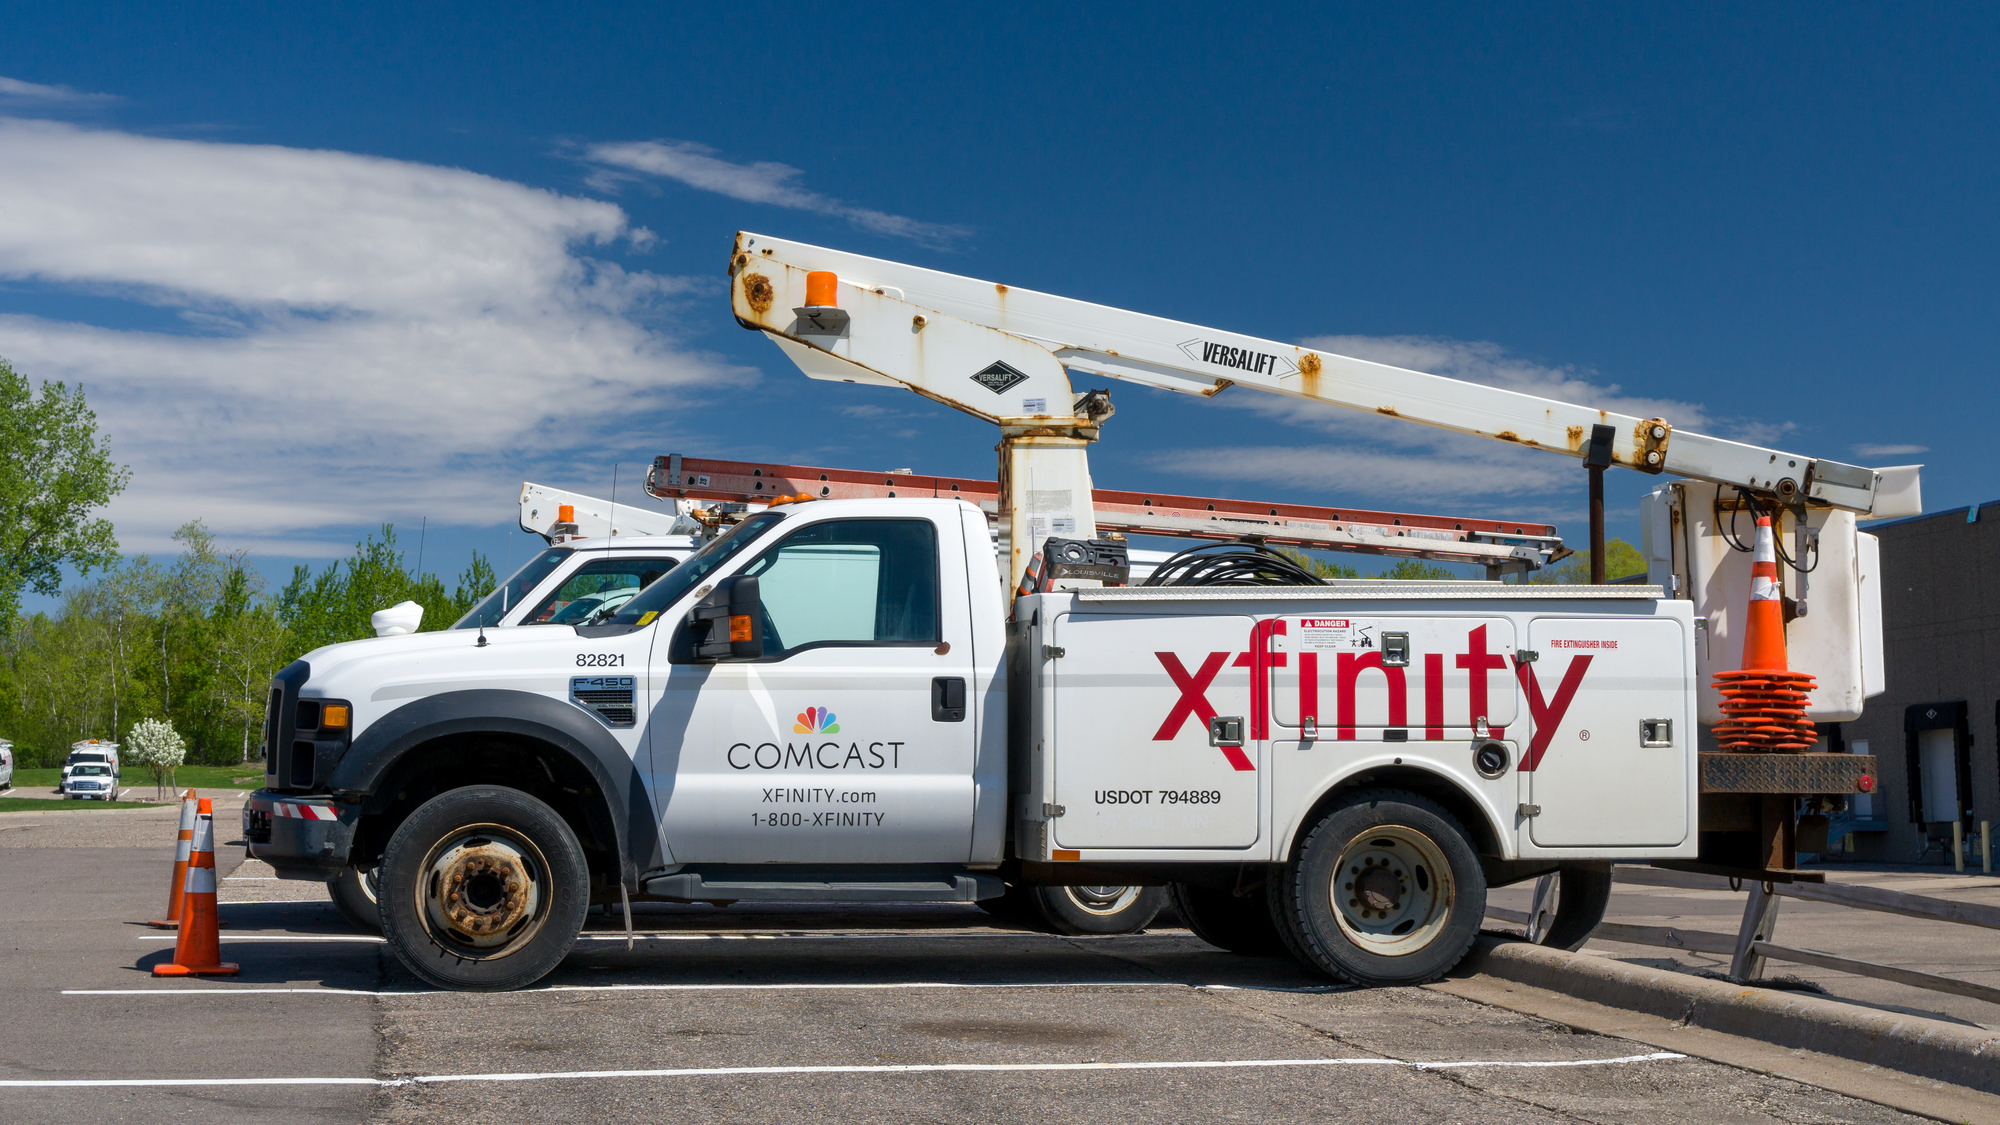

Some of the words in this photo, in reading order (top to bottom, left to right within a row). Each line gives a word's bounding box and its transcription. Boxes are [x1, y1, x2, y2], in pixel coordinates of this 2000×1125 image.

[1203, 341, 1278, 375] VERSALIFT
[978, 373, 1013, 382] VERSALIFT
[1068, 569, 1120, 579] LOUISVILLE
[1550, 639, 1562, 649] FIRE
[1563, 639, 1600, 649] EXTINGUISHER
[1601, 640, 1618, 649] INSIDE
[576, 653, 624, 667] 82821
[1152, 618, 1593, 772] xfinity
[727, 742, 905, 770] COMCAST
[762, 788, 876, 803] XFINITY.com
[1095, 790, 1153, 805] USDOT
[1158, 790, 1221, 805] 794889
[751, 812, 885, 827] 1-800-XFINITY
